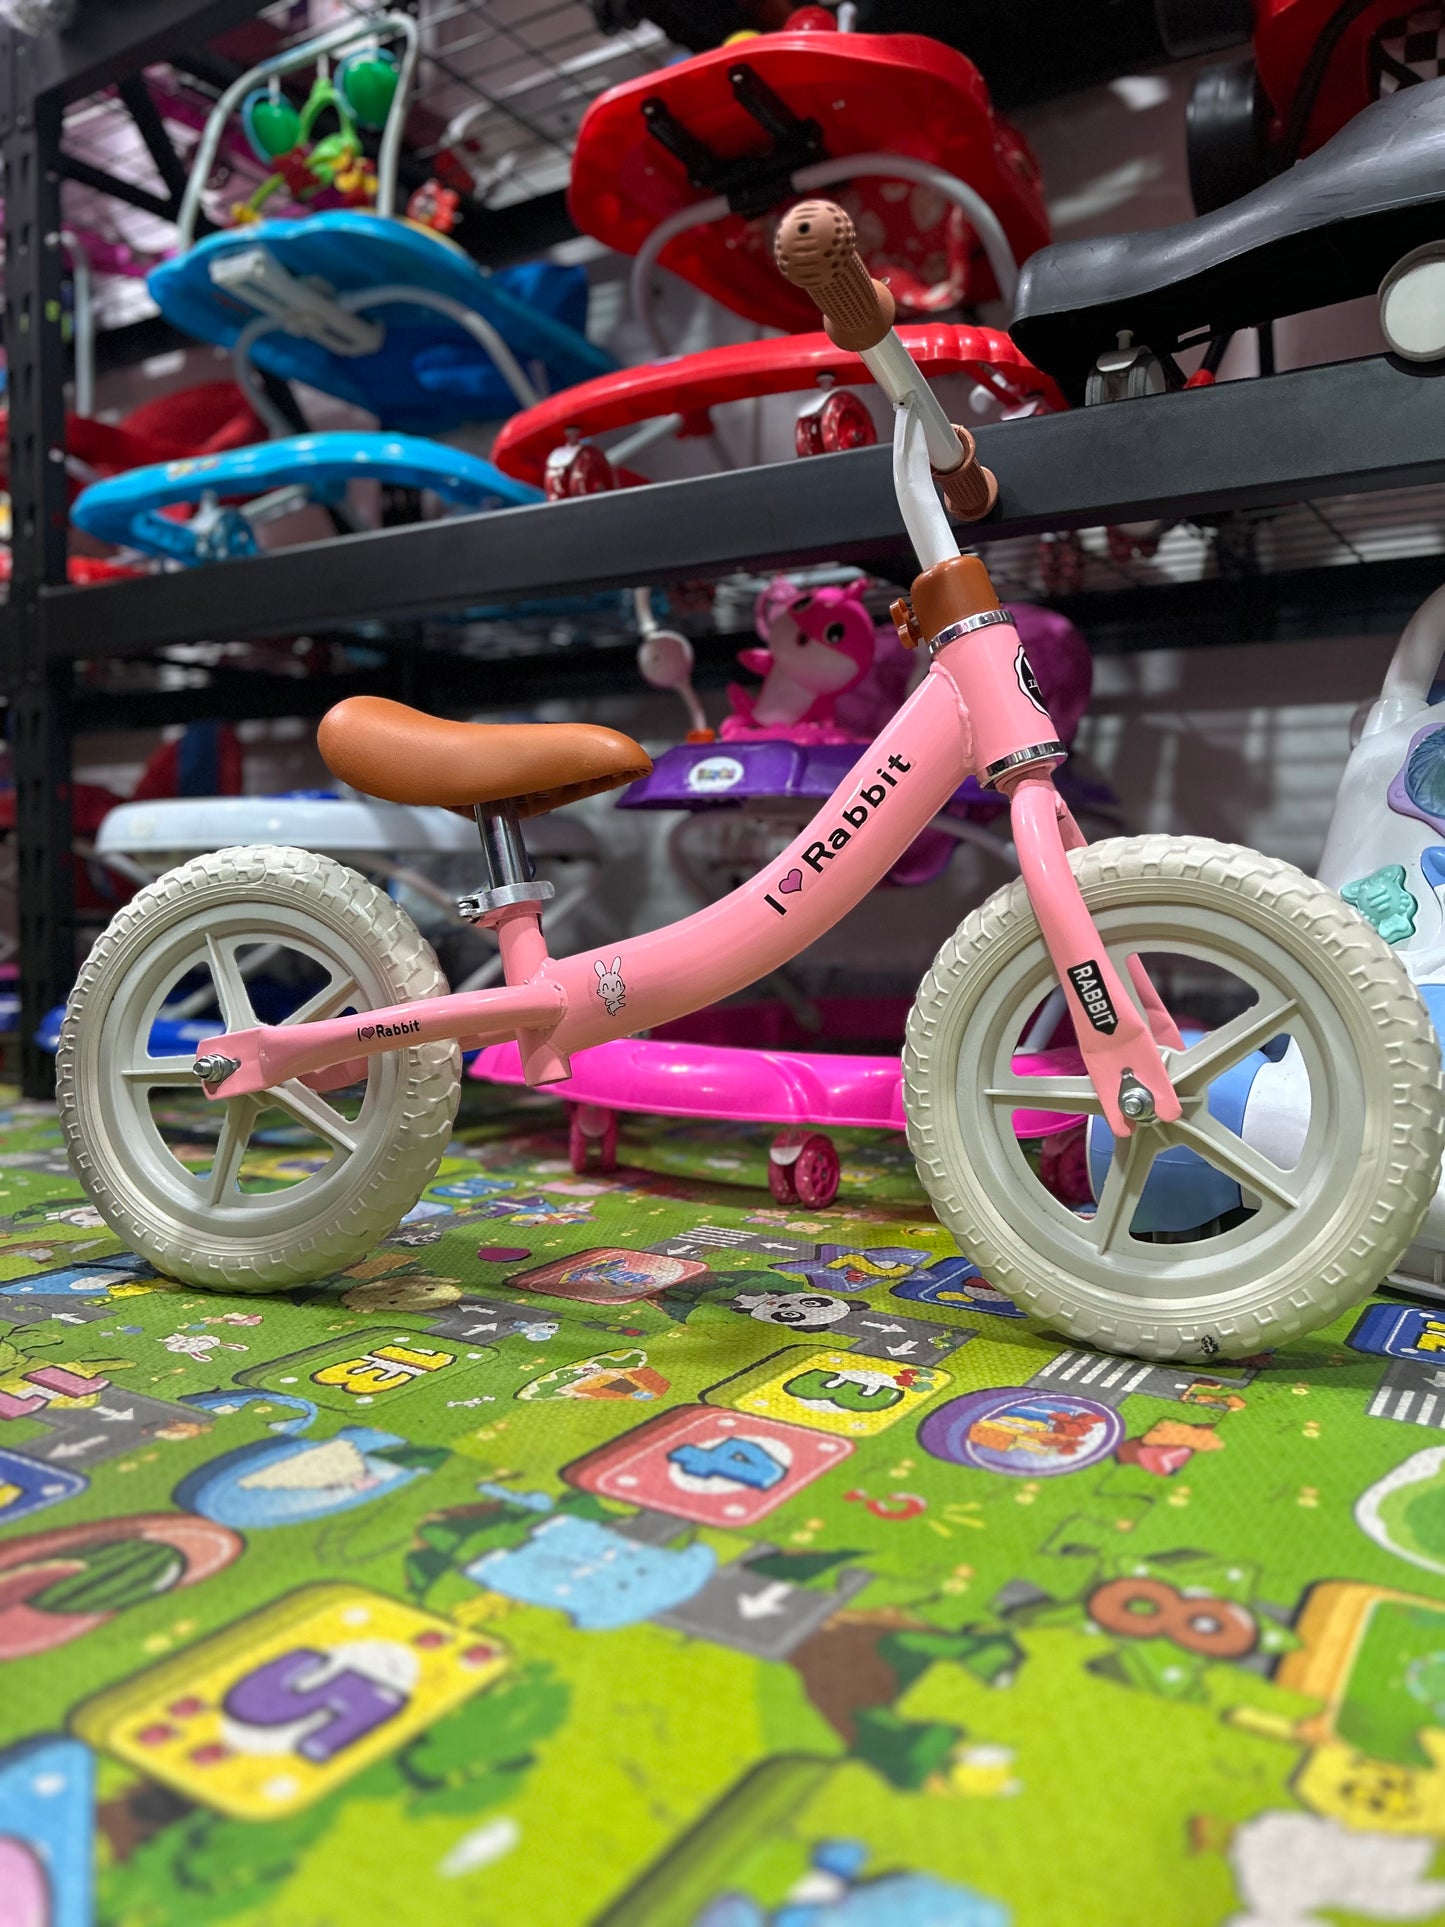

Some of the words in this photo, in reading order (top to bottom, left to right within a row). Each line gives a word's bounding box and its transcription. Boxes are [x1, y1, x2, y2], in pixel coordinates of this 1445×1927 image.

[763, 894, 787, 916] I
[801, 753, 912, 873] Rabbit
[1073, 965, 1115, 1026] RABBIT
[376, 1019, 420, 1038] Rabbit
[310, 1345, 458, 1394] 13
[783, 1369, 904, 1412] 3
[666, 1436, 788, 1492] 4
[1085, 1575, 1259, 1661] 8
[221, 1648, 410, 1766] 5
